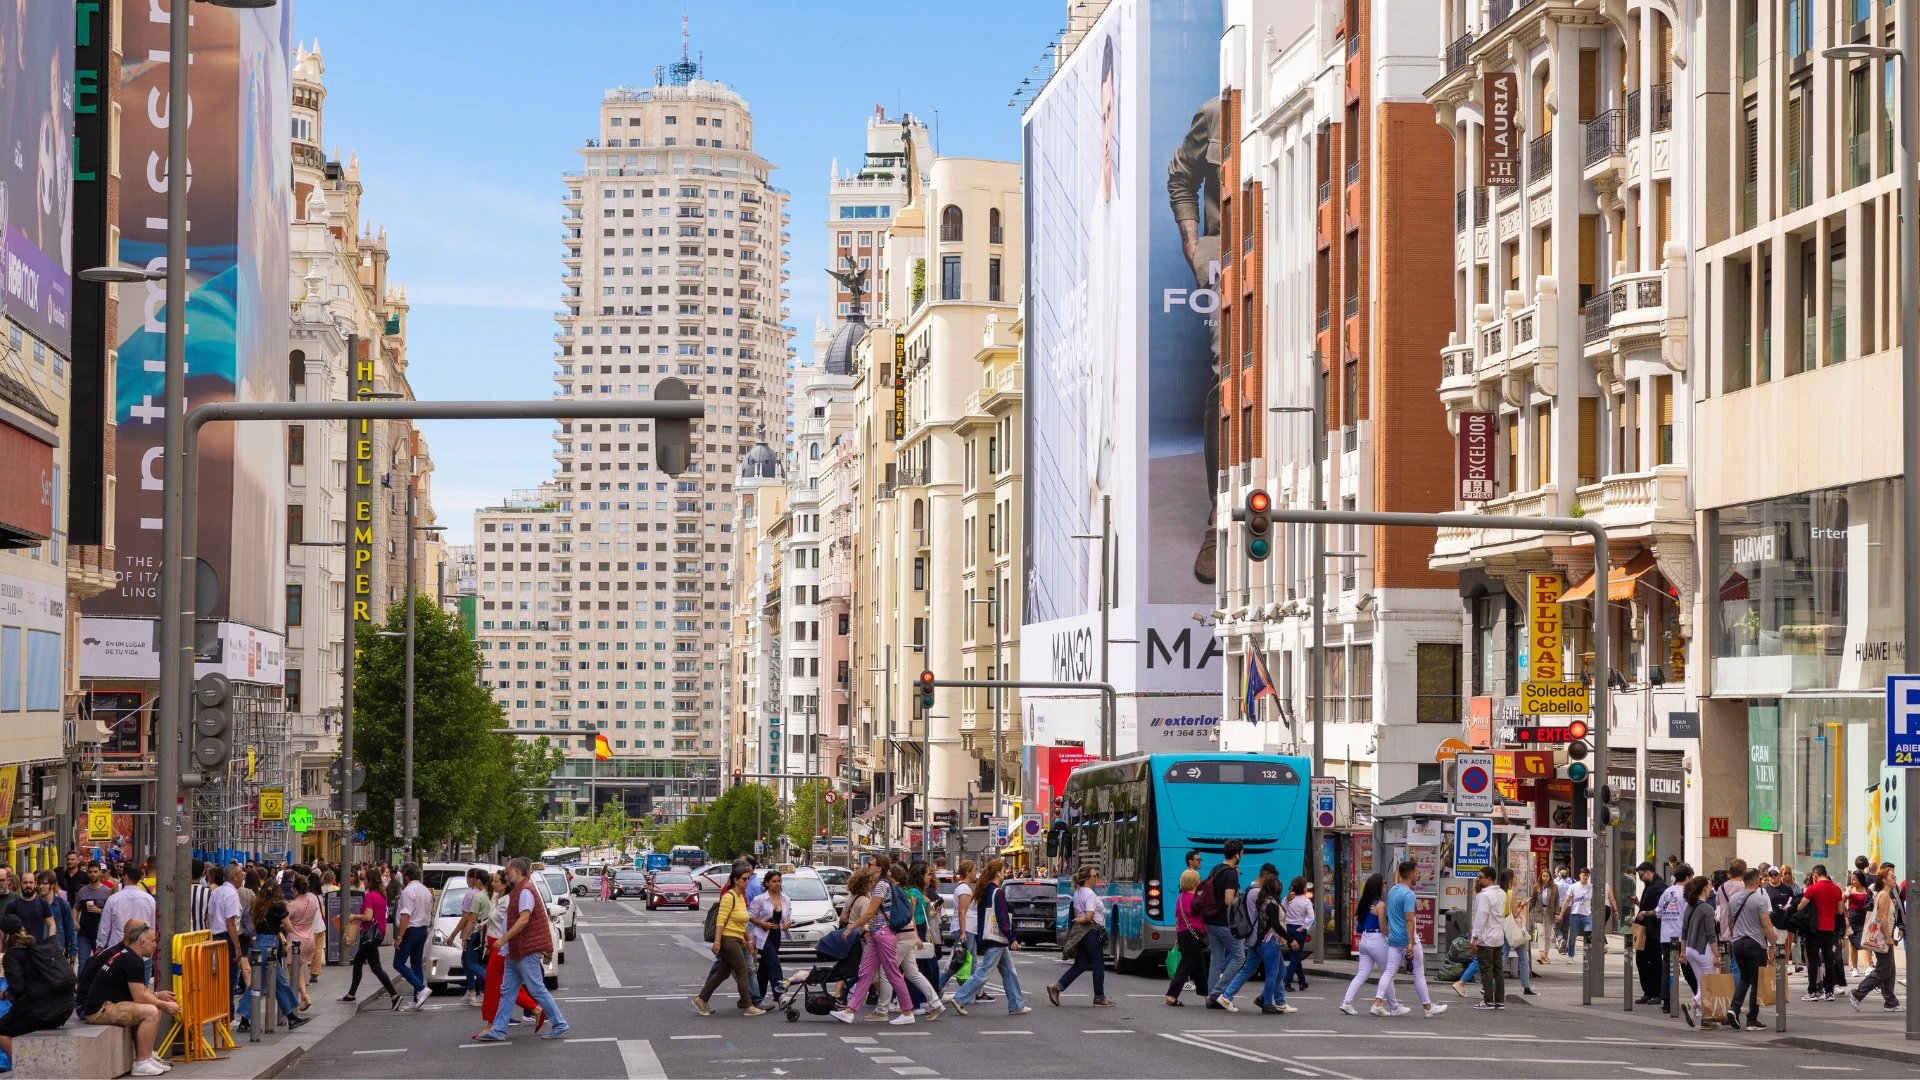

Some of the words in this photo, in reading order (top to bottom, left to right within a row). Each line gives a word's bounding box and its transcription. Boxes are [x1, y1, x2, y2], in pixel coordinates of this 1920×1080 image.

[1494, 76, 1509, 158] LAURIA
[131, 0, 193, 530] intimissi
[896, 337, 904, 375] HOSTAL
[896, 390, 904, 435] BESAYA
[1469, 415, 1486, 479] EXCELSIOR
[1733, 534, 1774, 563] HUAWEI
[126, 556, 153, 567] THE
[353, 502, 372, 621] EMPER
[114, 571, 132, 582] OF
[122, 587, 156, 598] LING
[1535, 576, 1558, 679] PELUCAS
[1052, 626, 1093, 682] MANGO
[1855, 642, 1891, 662] HUAWEI
[770, 636, 781, 713] SENATOR
[1526, 684, 1585, 697] Soledad
[1528, 699, 1583, 713] Cabello
[1165, 715, 1218, 727] exterior
[1196, 729, 1208, 737] 53
[1537, 728, 1574, 741] EXTE
[1751, 745, 1769, 762] GRAN
[1895, 752, 1912, 763] 24
[1262, 770, 1277, 779] 132
[1756, 764, 1775, 783] VIEW
[1650, 778, 1681, 794] DECIMAS
[1711, 818, 1728, 830] AT
[1460, 821, 1488, 857] P
